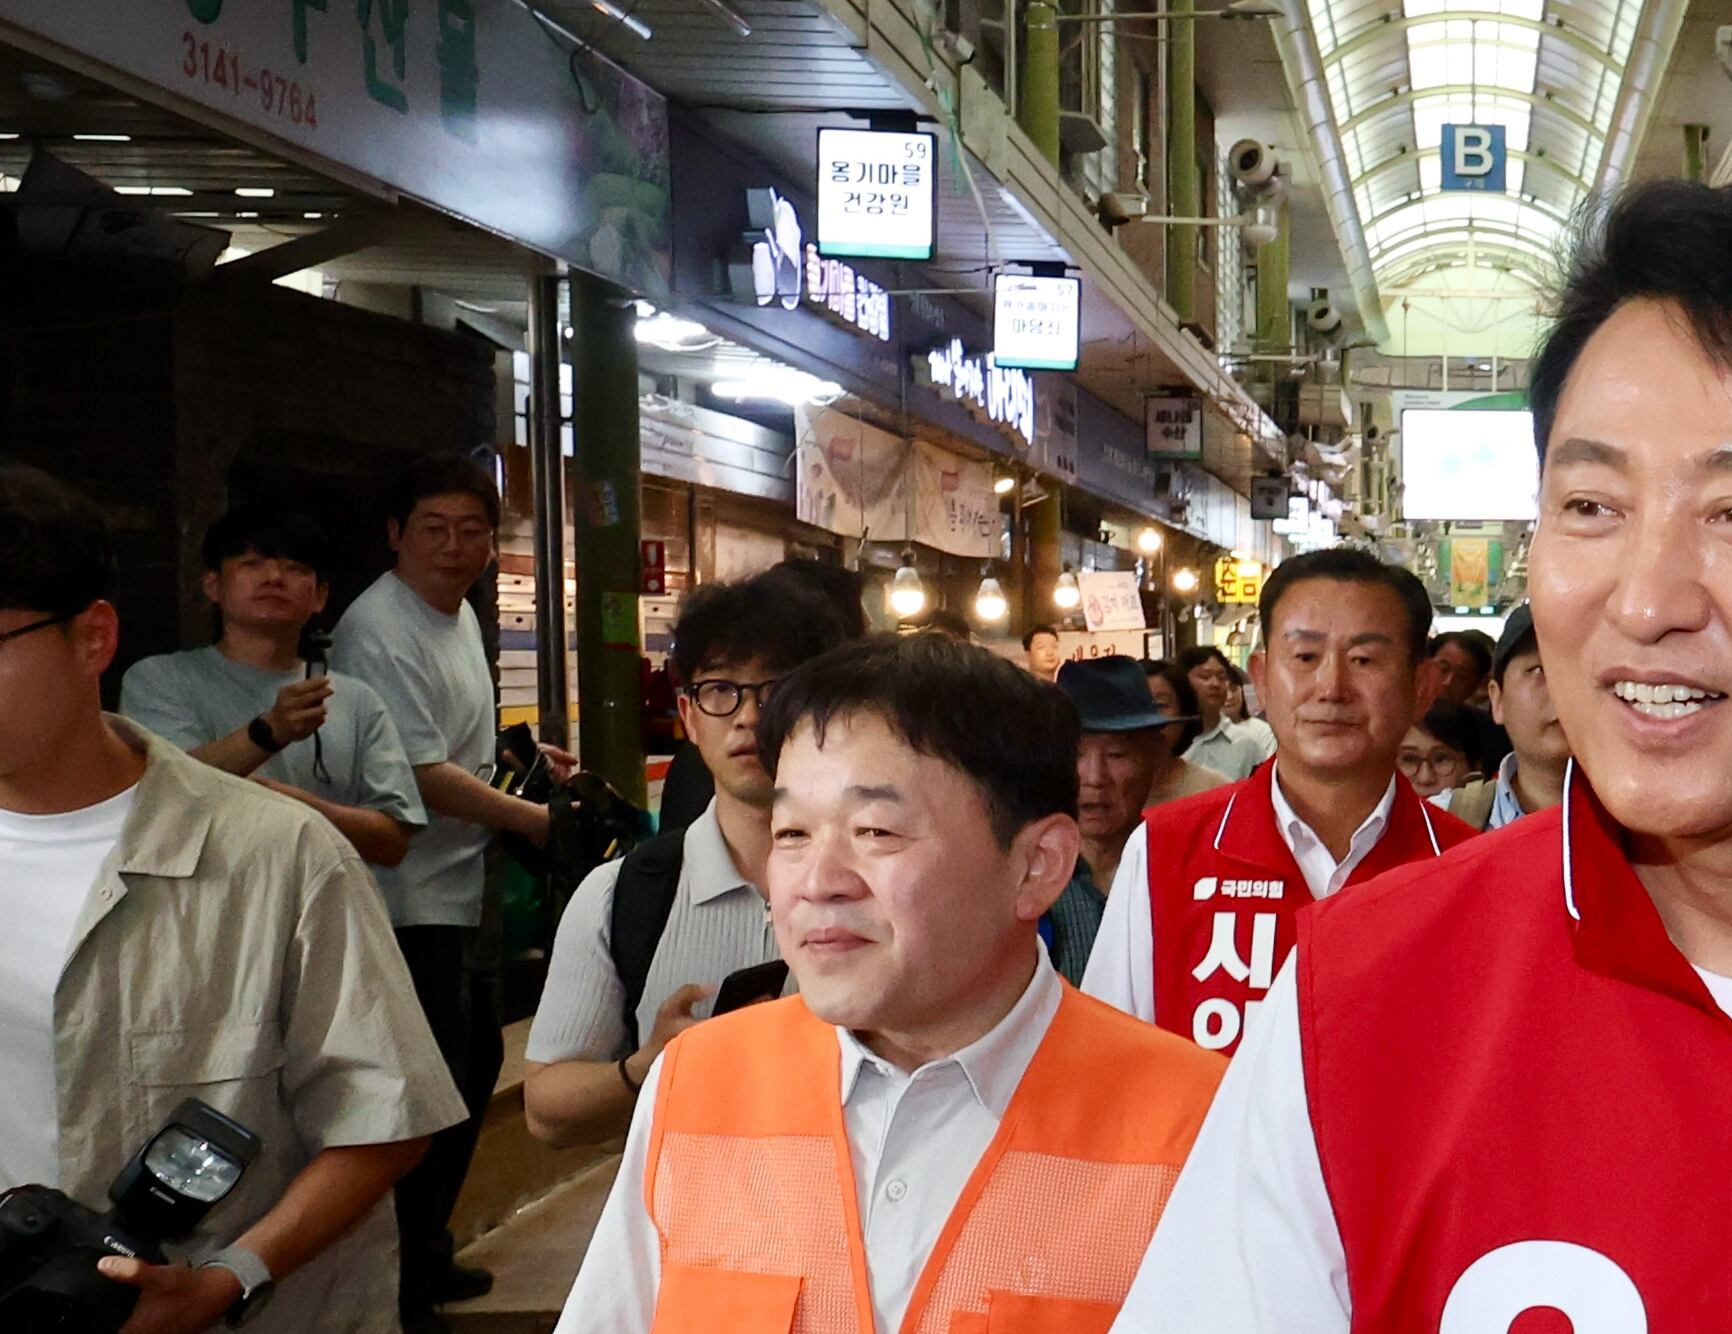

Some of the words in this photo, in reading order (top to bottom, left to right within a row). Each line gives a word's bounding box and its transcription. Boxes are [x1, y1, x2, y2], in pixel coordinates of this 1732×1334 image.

[182, 30, 318, 130] 3141-9764
[904, 141, 927, 159] 59
[1454, 127, 1494, 176] B
[831, 160, 922, 187] 옹기마을
[843, 191, 909, 216] 건강원
[1221, 879, 1284, 899] 국민의힘
